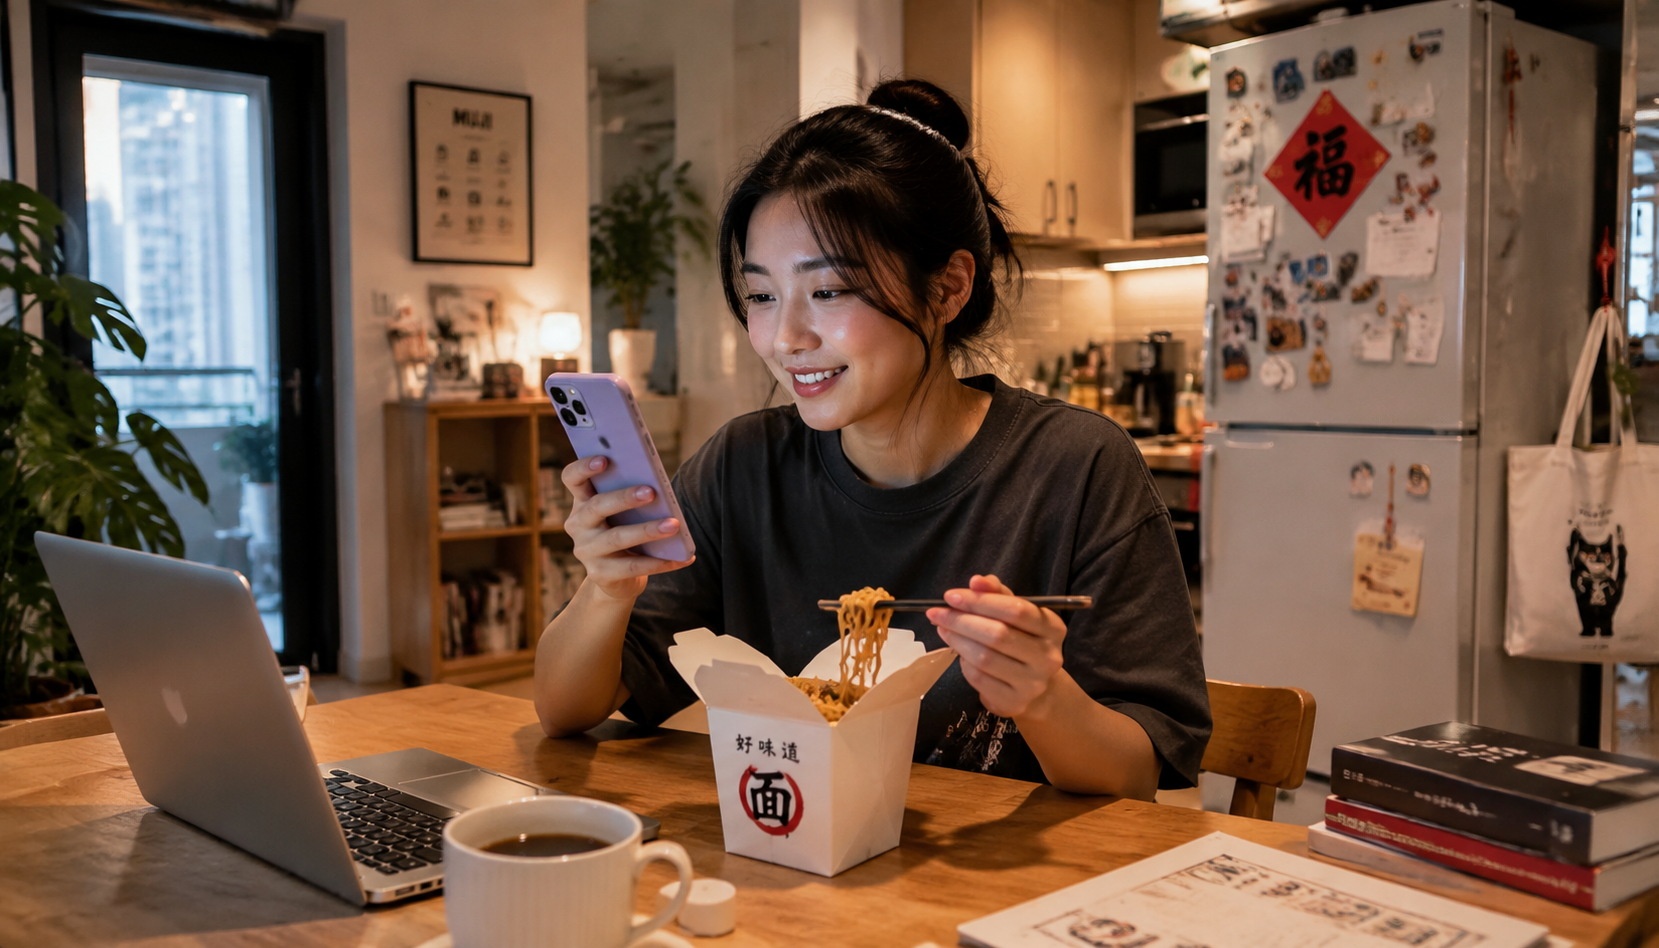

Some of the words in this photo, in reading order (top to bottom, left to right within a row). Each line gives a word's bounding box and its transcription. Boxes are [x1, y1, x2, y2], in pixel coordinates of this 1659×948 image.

[1294, 125, 1355, 201] 福
[735, 733, 800, 764] 好味道
[750, 771, 792, 827] 面
